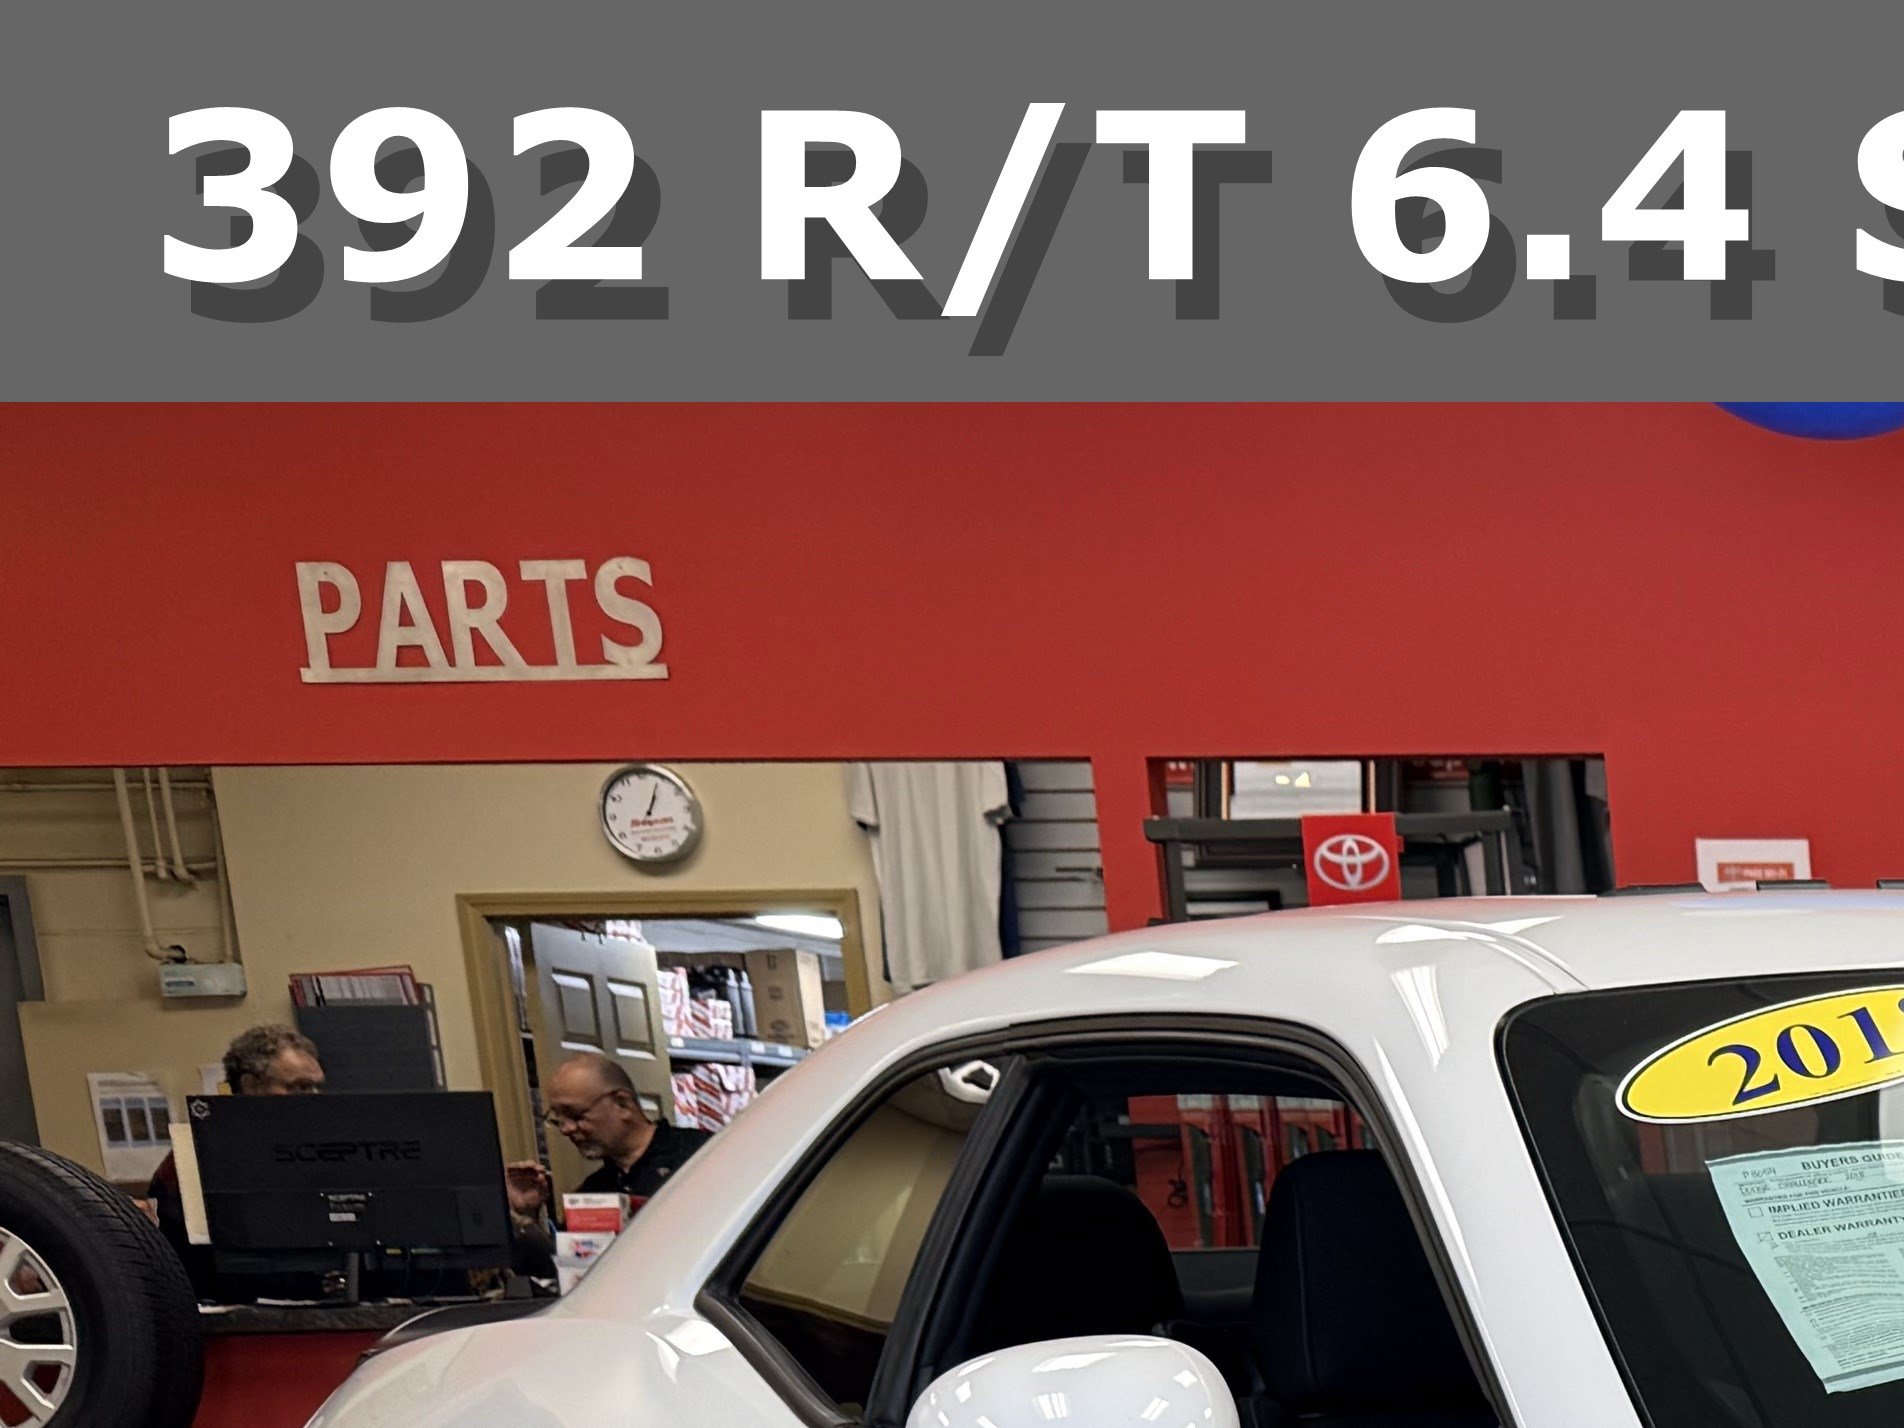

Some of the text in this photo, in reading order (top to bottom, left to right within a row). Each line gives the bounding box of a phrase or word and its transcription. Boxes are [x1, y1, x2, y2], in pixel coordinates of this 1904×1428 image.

[295, 556, 667, 680] PARTS
[274, 1139, 421, 1163] SCEPTRE
[1801, 1154, 1860, 1171] BUYERS
[1767, 1201, 1821, 1214] IMPLIED
[1777, 1226, 1831, 1240] DEALER
